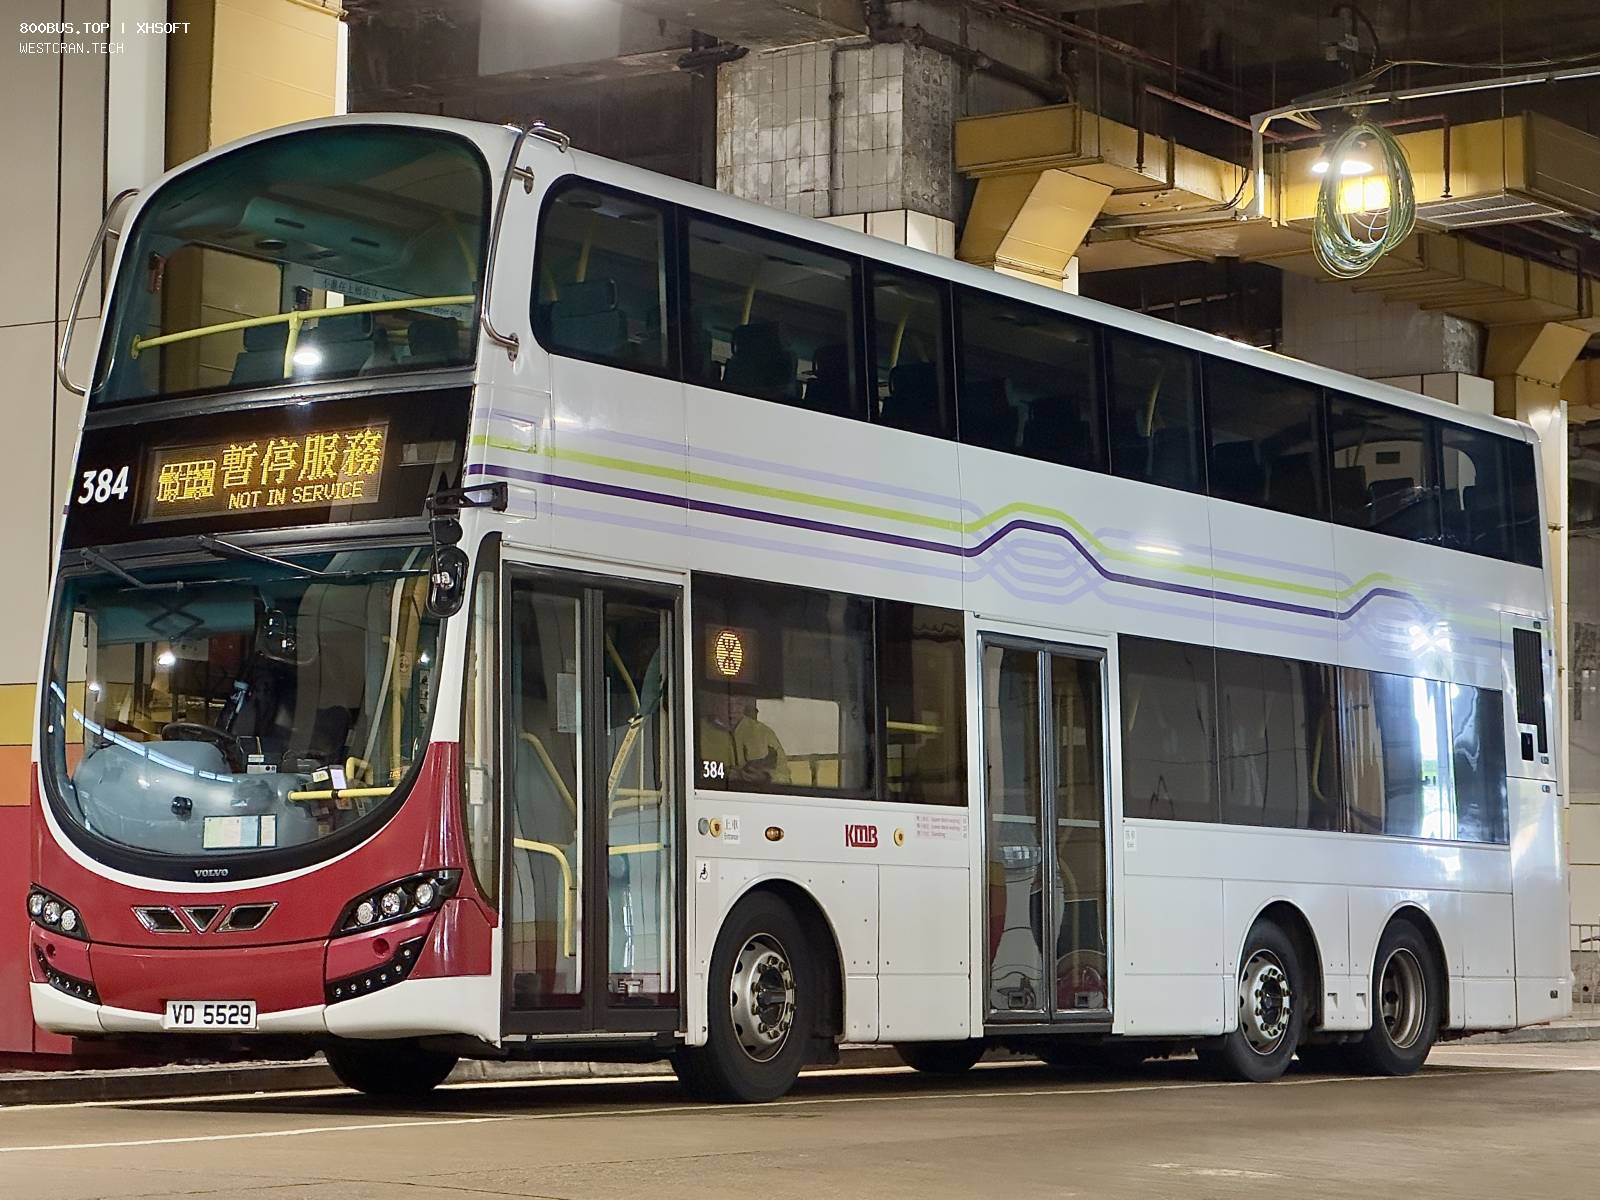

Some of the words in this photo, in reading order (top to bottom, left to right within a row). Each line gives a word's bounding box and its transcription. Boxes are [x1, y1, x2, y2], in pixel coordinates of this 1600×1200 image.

[220, 428, 383, 489] 暫停服務
[78, 466, 130, 505] 384
[228, 490, 262, 510] NOT
[267, 488, 286, 506] IN
[292, 481, 364, 503] SERVICE
[702, 761, 725, 779] 384
[845, 824, 878, 848] KMB
[194, 868, 229, 877] VOLVO
[172, 1004, 195, 1025] VD
[203, 1004, 252, 1025] 5529
